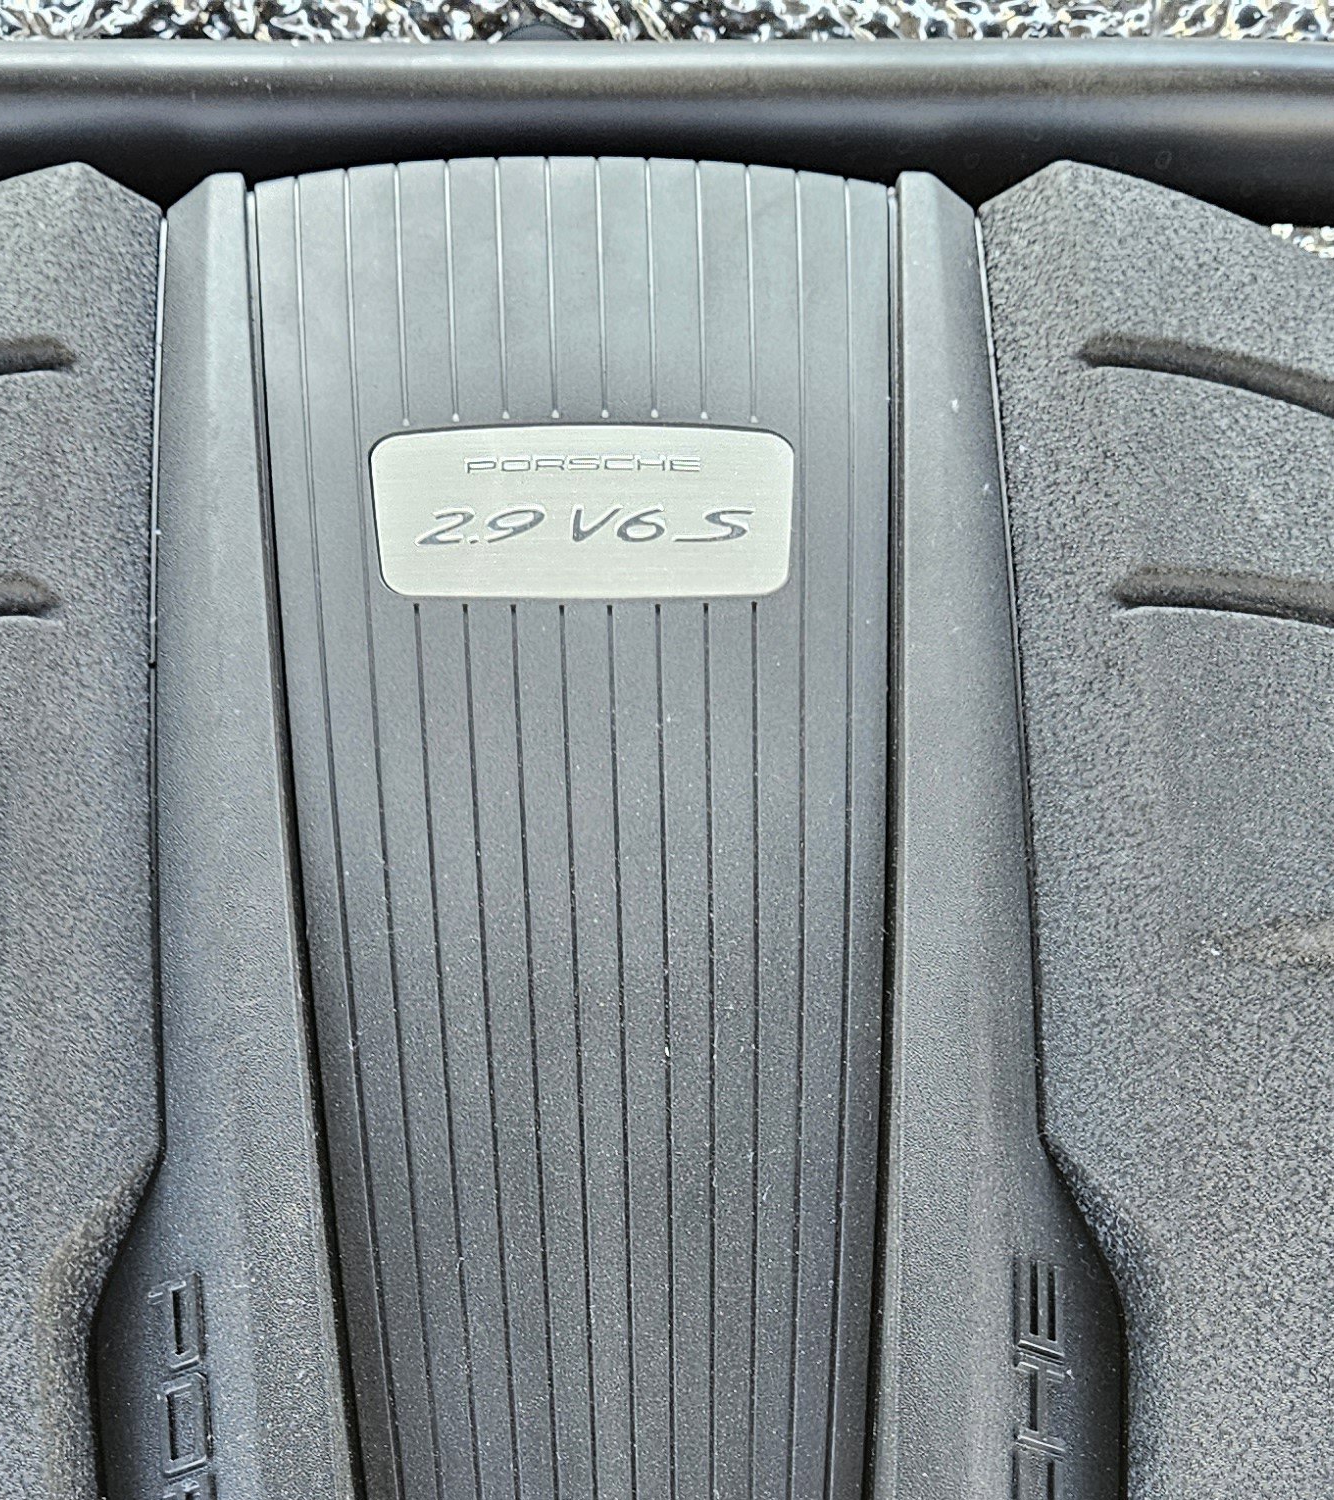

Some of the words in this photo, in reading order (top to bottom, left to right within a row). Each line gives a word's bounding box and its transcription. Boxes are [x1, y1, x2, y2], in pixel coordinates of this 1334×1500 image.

[465, 455, 702, 474] PORSCHE
[414, 504, 546, 546] 2.9
[571, 504, 666, 543] V6
[672, 507, 756, 543] S
